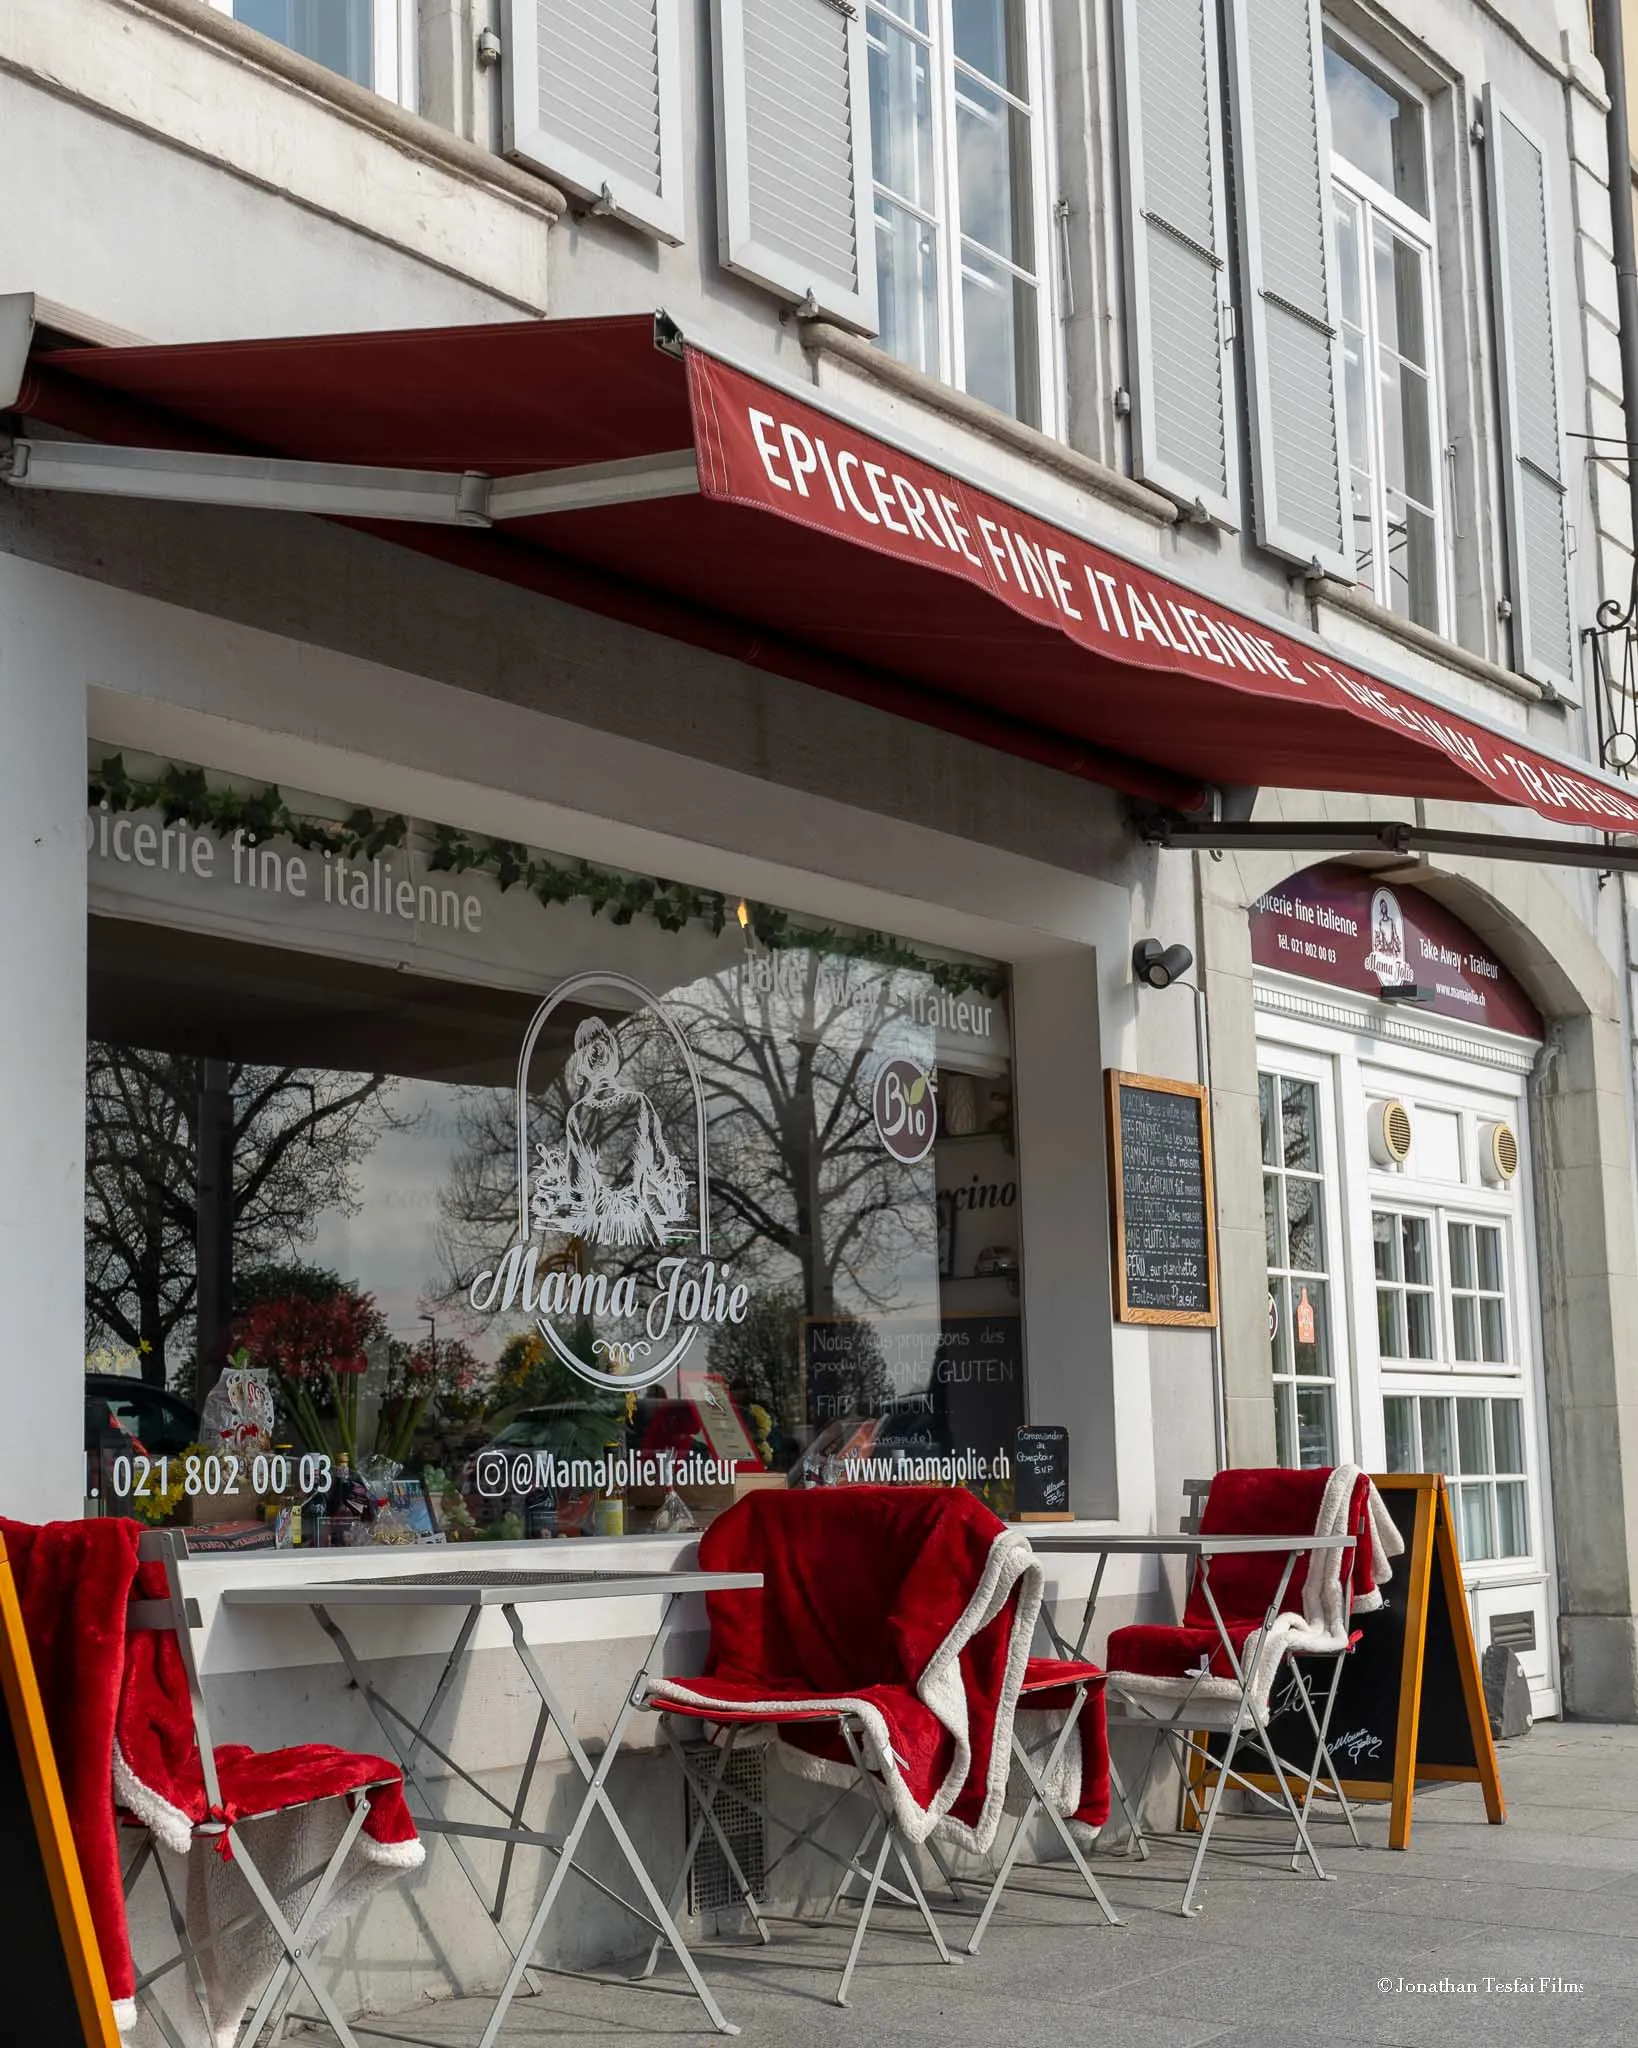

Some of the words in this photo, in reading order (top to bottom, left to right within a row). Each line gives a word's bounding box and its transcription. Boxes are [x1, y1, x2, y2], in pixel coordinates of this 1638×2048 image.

[748, 407, 983, 569] EPICERIE
[977, 514, 1083, 621] FINE
[1084, 565, 1308, 685] ITALIENNE
[231, 828, 308, 898] fine
[323, 849, 484, 934] italienne
[1295, 897, 1315, 924] fine
[1316, 904, 1359, 937] italienne
[1277, 933, 1290, 951] Tél.
[1291, 938, 1304, 955] 021
[1305, 941, 1318, 959] 802
[1318, 945, 1328, 961] 00
[1328, 948, 1337, 964] 03
[1420, 938, 1439, 962] Take
[1440, 944, 1462, 973] Away
[1469, 954, 1499, 979] Traiteur
[906, 987, 992, 1037] Traiteur
[882, 1071, 926, 1136] Bio
[1143, 1228, 1169, 1249] GLUTEN
[1150, 1265, 1161, 1277] sur
[470, 1244, 639, 1317] Mama
[646, 1256, 749, 1341] Jolie
[813, 1329, 852, 1353] Nous
[896, 1332, 970, 1360] proposons
[979, 1325, 1006, 1345] des
[936, 1359, 1015, 1384] GLUTEN
[112, 1455, 169, 1497] 021
[184, 1455, 240, 1496] 802
[251, 1455, 288, 1495] 00
[299, 1454, 333, 1494] 03
[511, 1448, 738, 1496] @MamaJolieTraiteur
[844, 1447, 1011, 1488] www.mamajolie.ch
